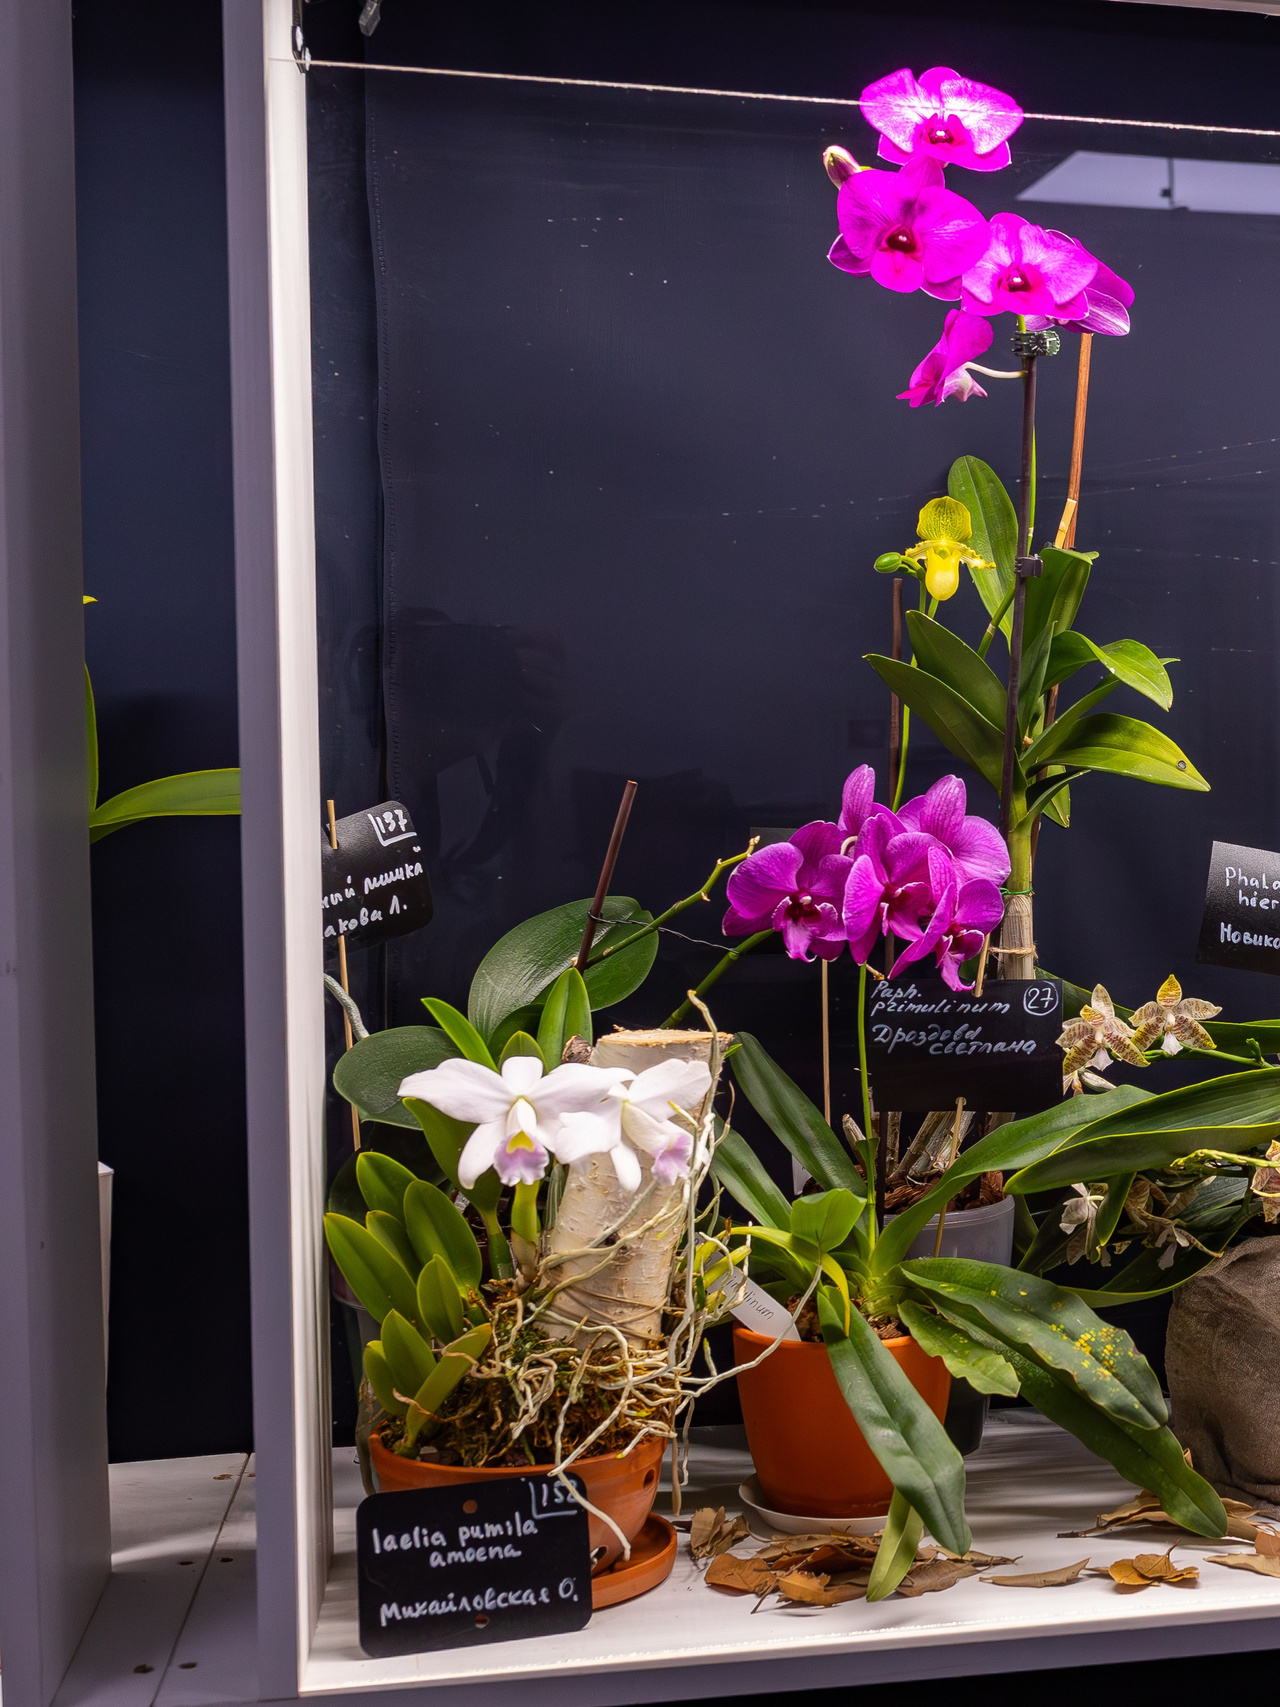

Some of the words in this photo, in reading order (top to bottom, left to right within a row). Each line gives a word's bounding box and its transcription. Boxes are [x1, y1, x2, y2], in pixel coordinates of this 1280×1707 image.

[322, 907, 383, 938] акова
[871, 980, 922, 1003] Paph.
[1027, 987, 1054, 1009] 27
[872, 1023, 982, 1054] Дроздова
[458, 1511, 539, 1547] pumila
[430, 1543, 522, 1568] amoena
[558, 1577, 579, 1602] О.
